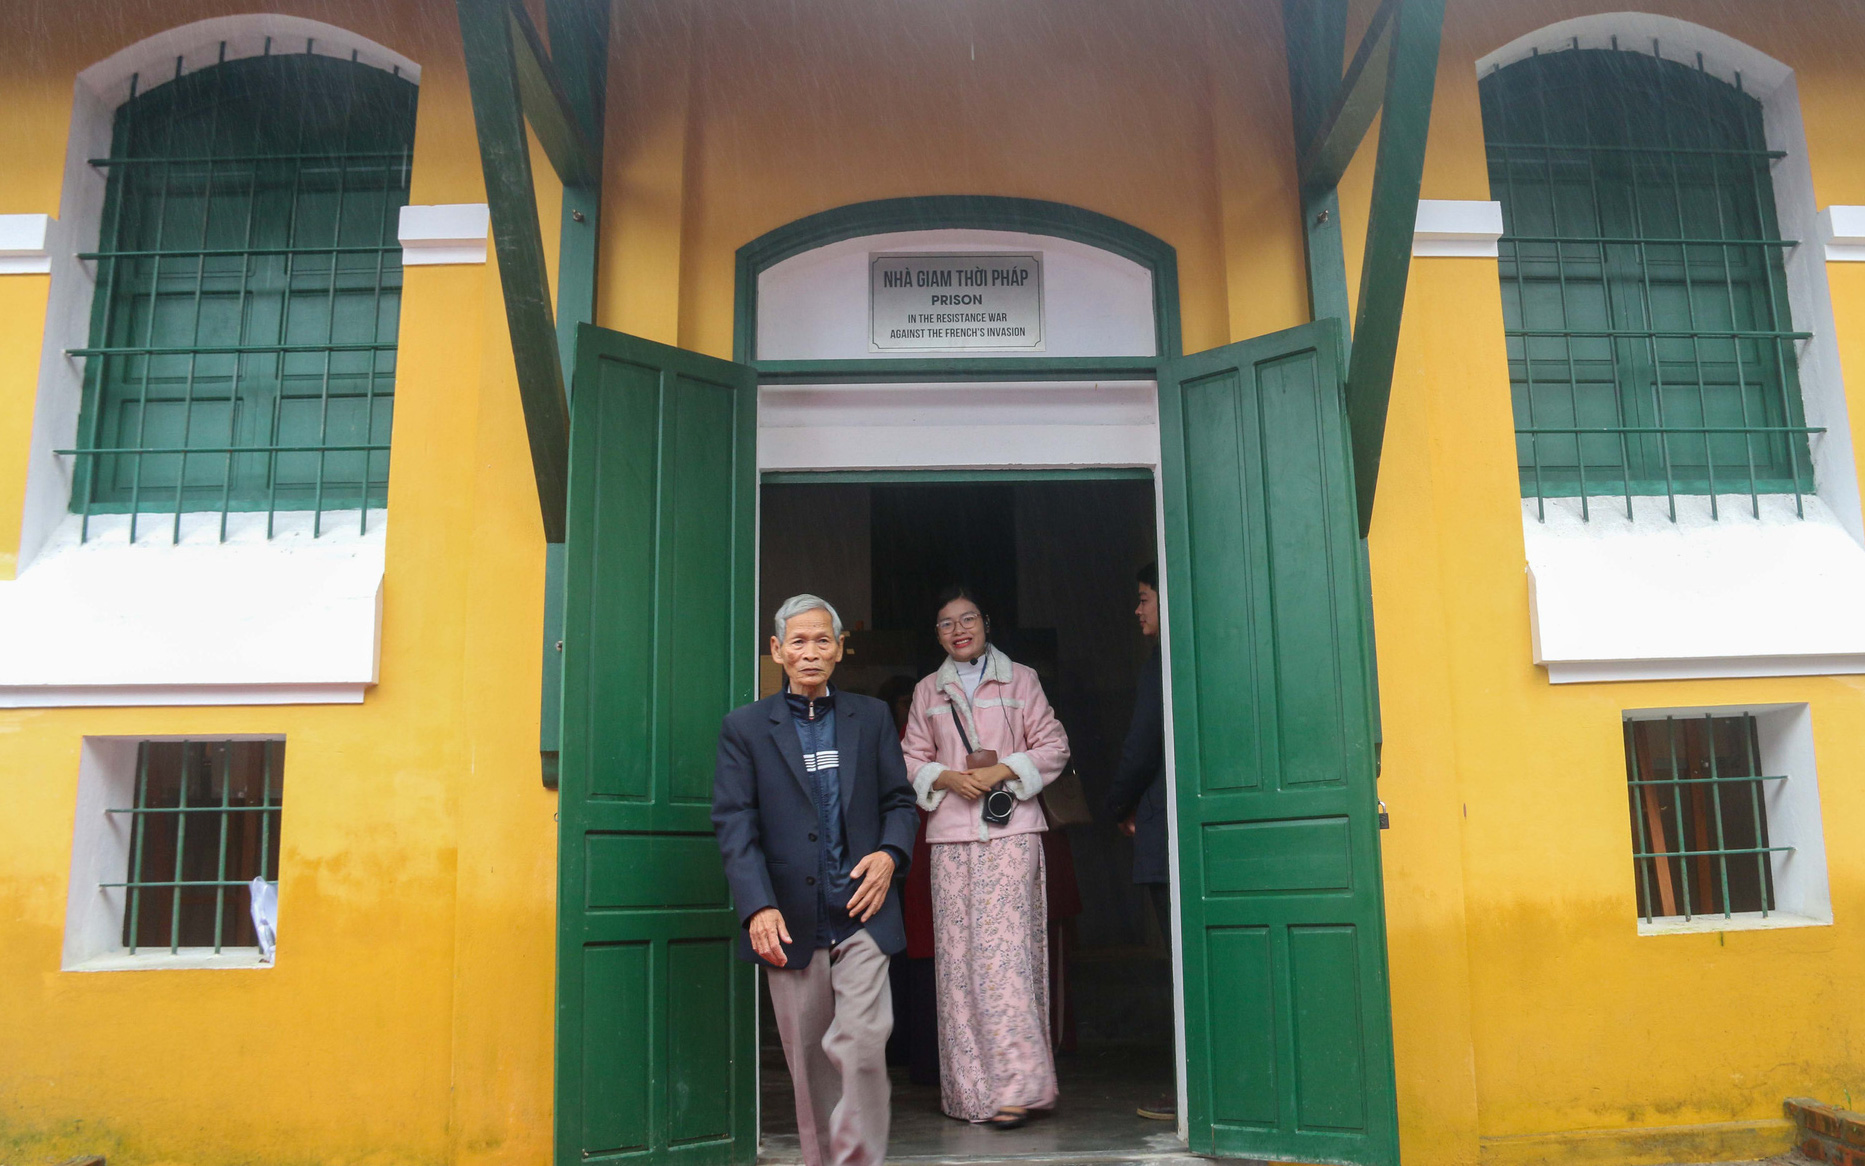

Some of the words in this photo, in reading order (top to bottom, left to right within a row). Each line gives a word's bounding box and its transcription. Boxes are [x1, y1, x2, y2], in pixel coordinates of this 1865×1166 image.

[884, 267, 913, 288] NHÀ
[917, 270, 952, 288] GIAM
[956, 266, 988, 287] THỜI
[992, 266, 1029, 286] PHÁP
[931, 294, 983, 306] PRISON
[908, 314, 917, 324] IN
[919, 314, 934, 323] THE
[936, 313, 987, 323] RESISTANCE
[988, 313, 1007, 322] WAR
[890, 329, 925, 339] AGAINST
[927, 329, 943, 338] THE
[945, 328, 985, 338] FRENCH'S
[987, 327, 1026, 337] INVASION
